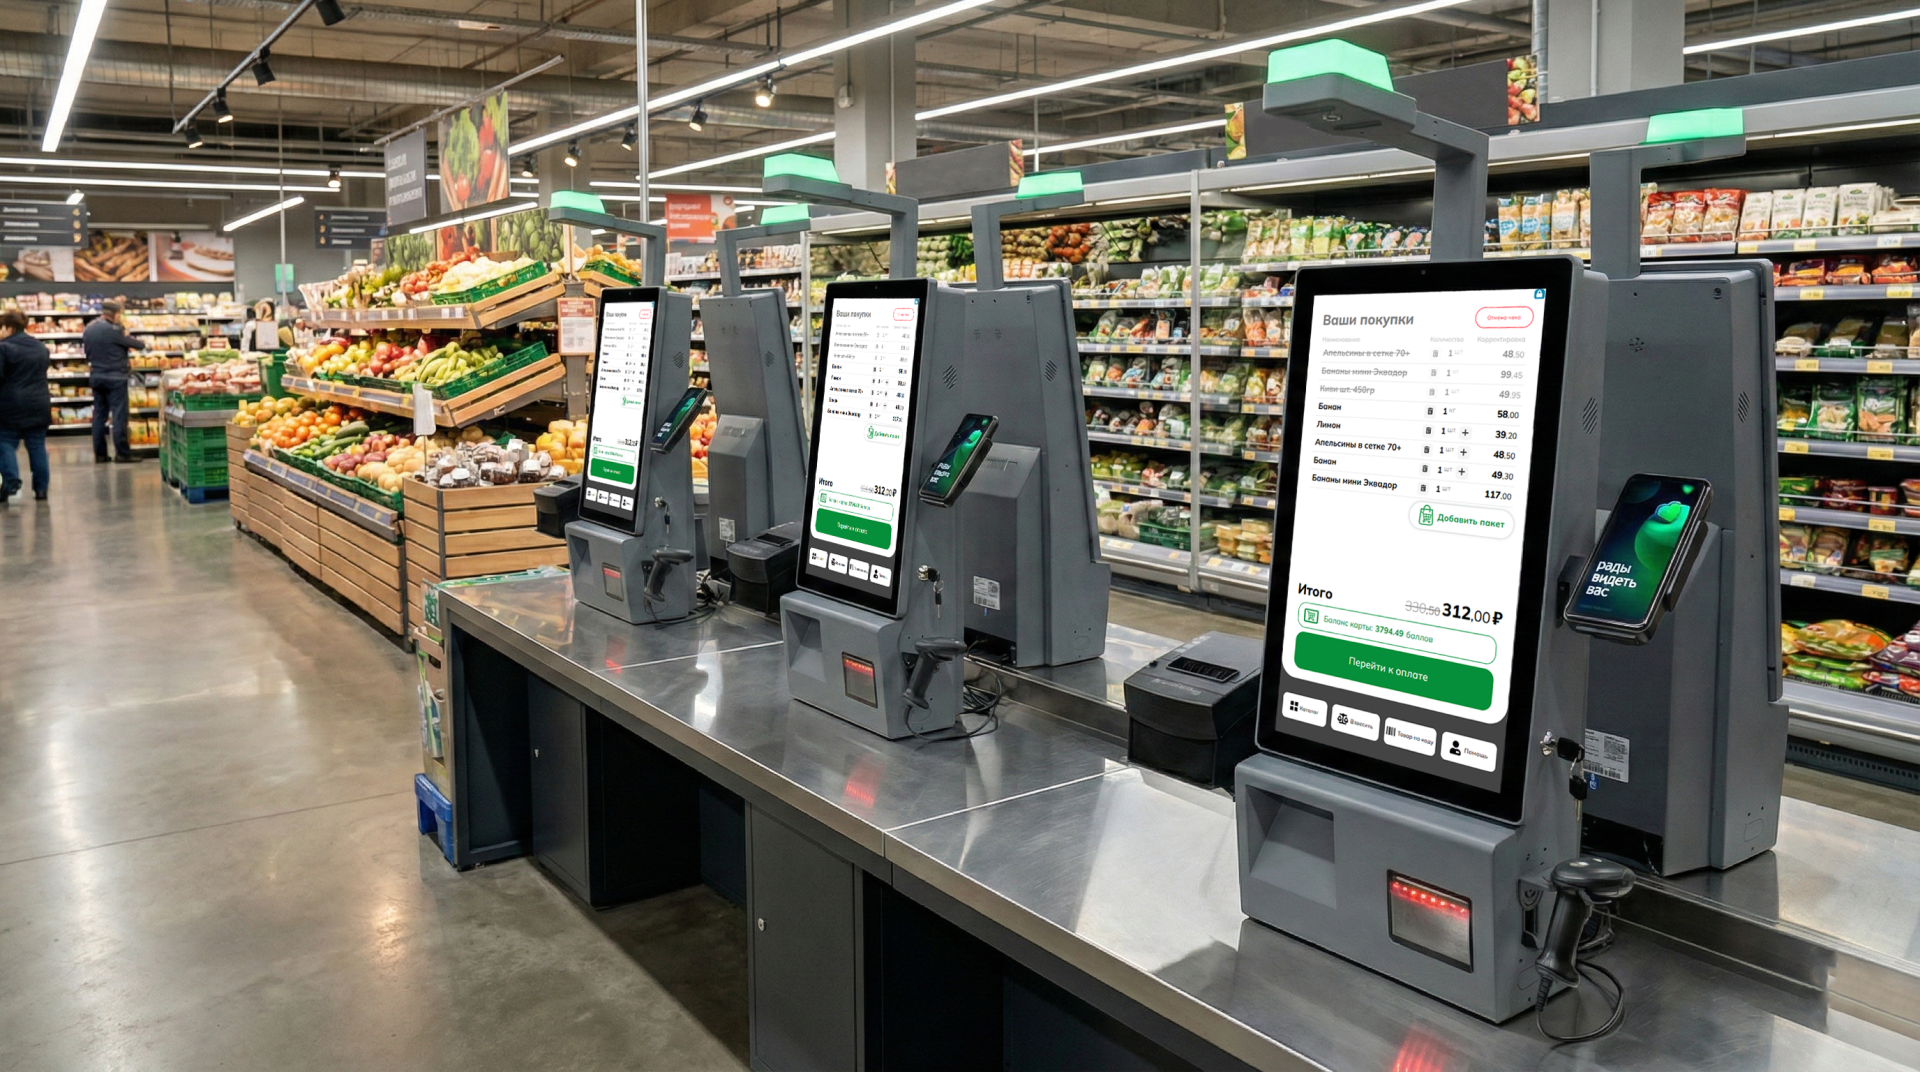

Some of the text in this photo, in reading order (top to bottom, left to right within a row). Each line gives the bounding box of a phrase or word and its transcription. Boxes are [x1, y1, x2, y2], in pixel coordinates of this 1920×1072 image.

[1323, 315, 1414, 328] Ваши покупки
[1321, 367, 1351, 375] Бананы
[1373, 368, 1407, 378] Эквадор
[1318, 402, 1341, 410] Банан
[1317, 421, 1341, 429] Лимон
[1315, 439, 1356, 448] Апельсины
[1388, 443, 1401, 451] 70+
[1314, 456, 1336, 465] Банан
[819, 478, 833, 487] Итого
[1312, 474, 1341, 483] Бананы
[1363, 479, 1397, 491] Эквадор
[1437, 514, 1505, 528] Добавить пакет
[1595, 561, 1631, 574] рады
[1591, 573, 1637, 588] видеть
[1298, 583, 1332, 599] Итого
[1586, 586, 1609, 597] вас
[1324, 615, 1433, 643] Баланс карты: 3794.49 баллов
[1349, 657, 1386, 672] Перейти
[1396, 669, 1428, 681] оплате
[1398, 731, 1413, 740] Товар
[1464, 748, 1488, 759] Помощь
